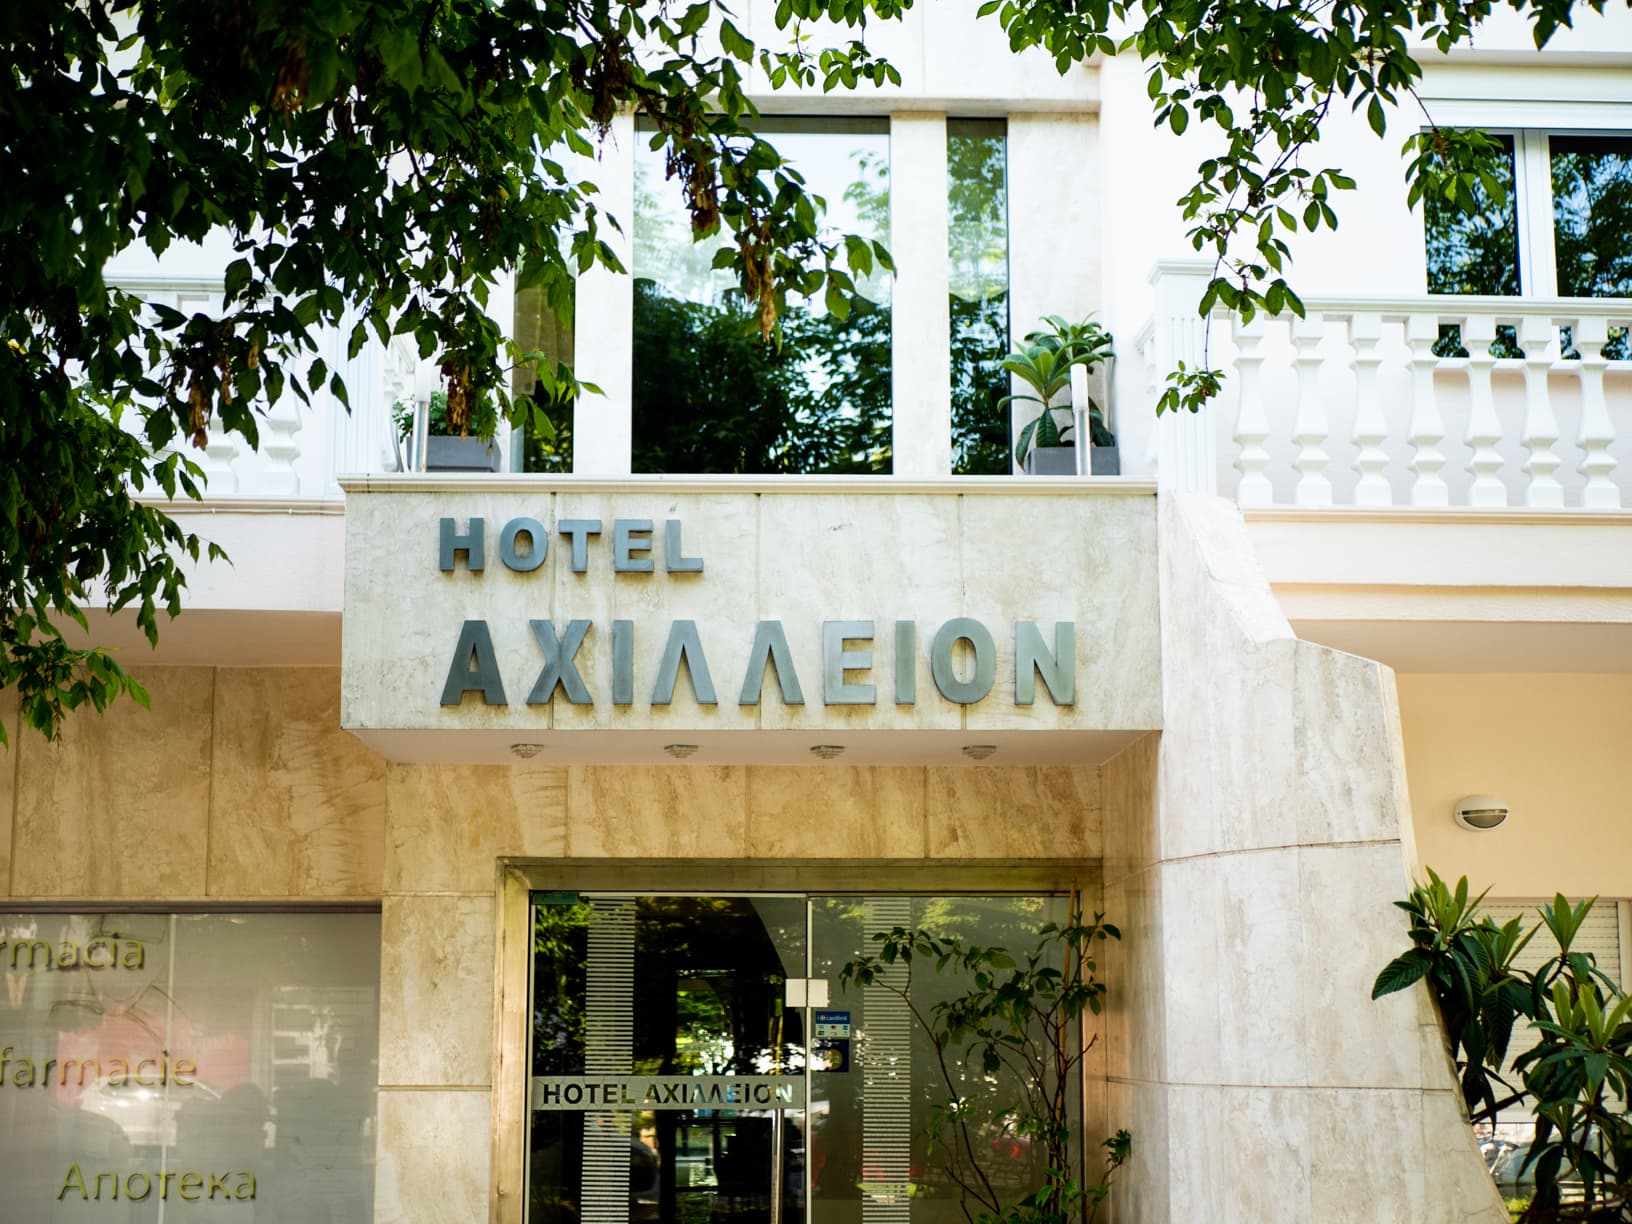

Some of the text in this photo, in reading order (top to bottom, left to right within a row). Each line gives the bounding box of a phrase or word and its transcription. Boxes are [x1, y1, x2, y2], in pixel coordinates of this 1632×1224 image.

[439, 517, 704, 574] HOTEL
[0, 1046, 197, 1088] farmacie
[542, 1083, 636, 1105] HOTEL
[56, 1160, 258, 1201] Апотека
